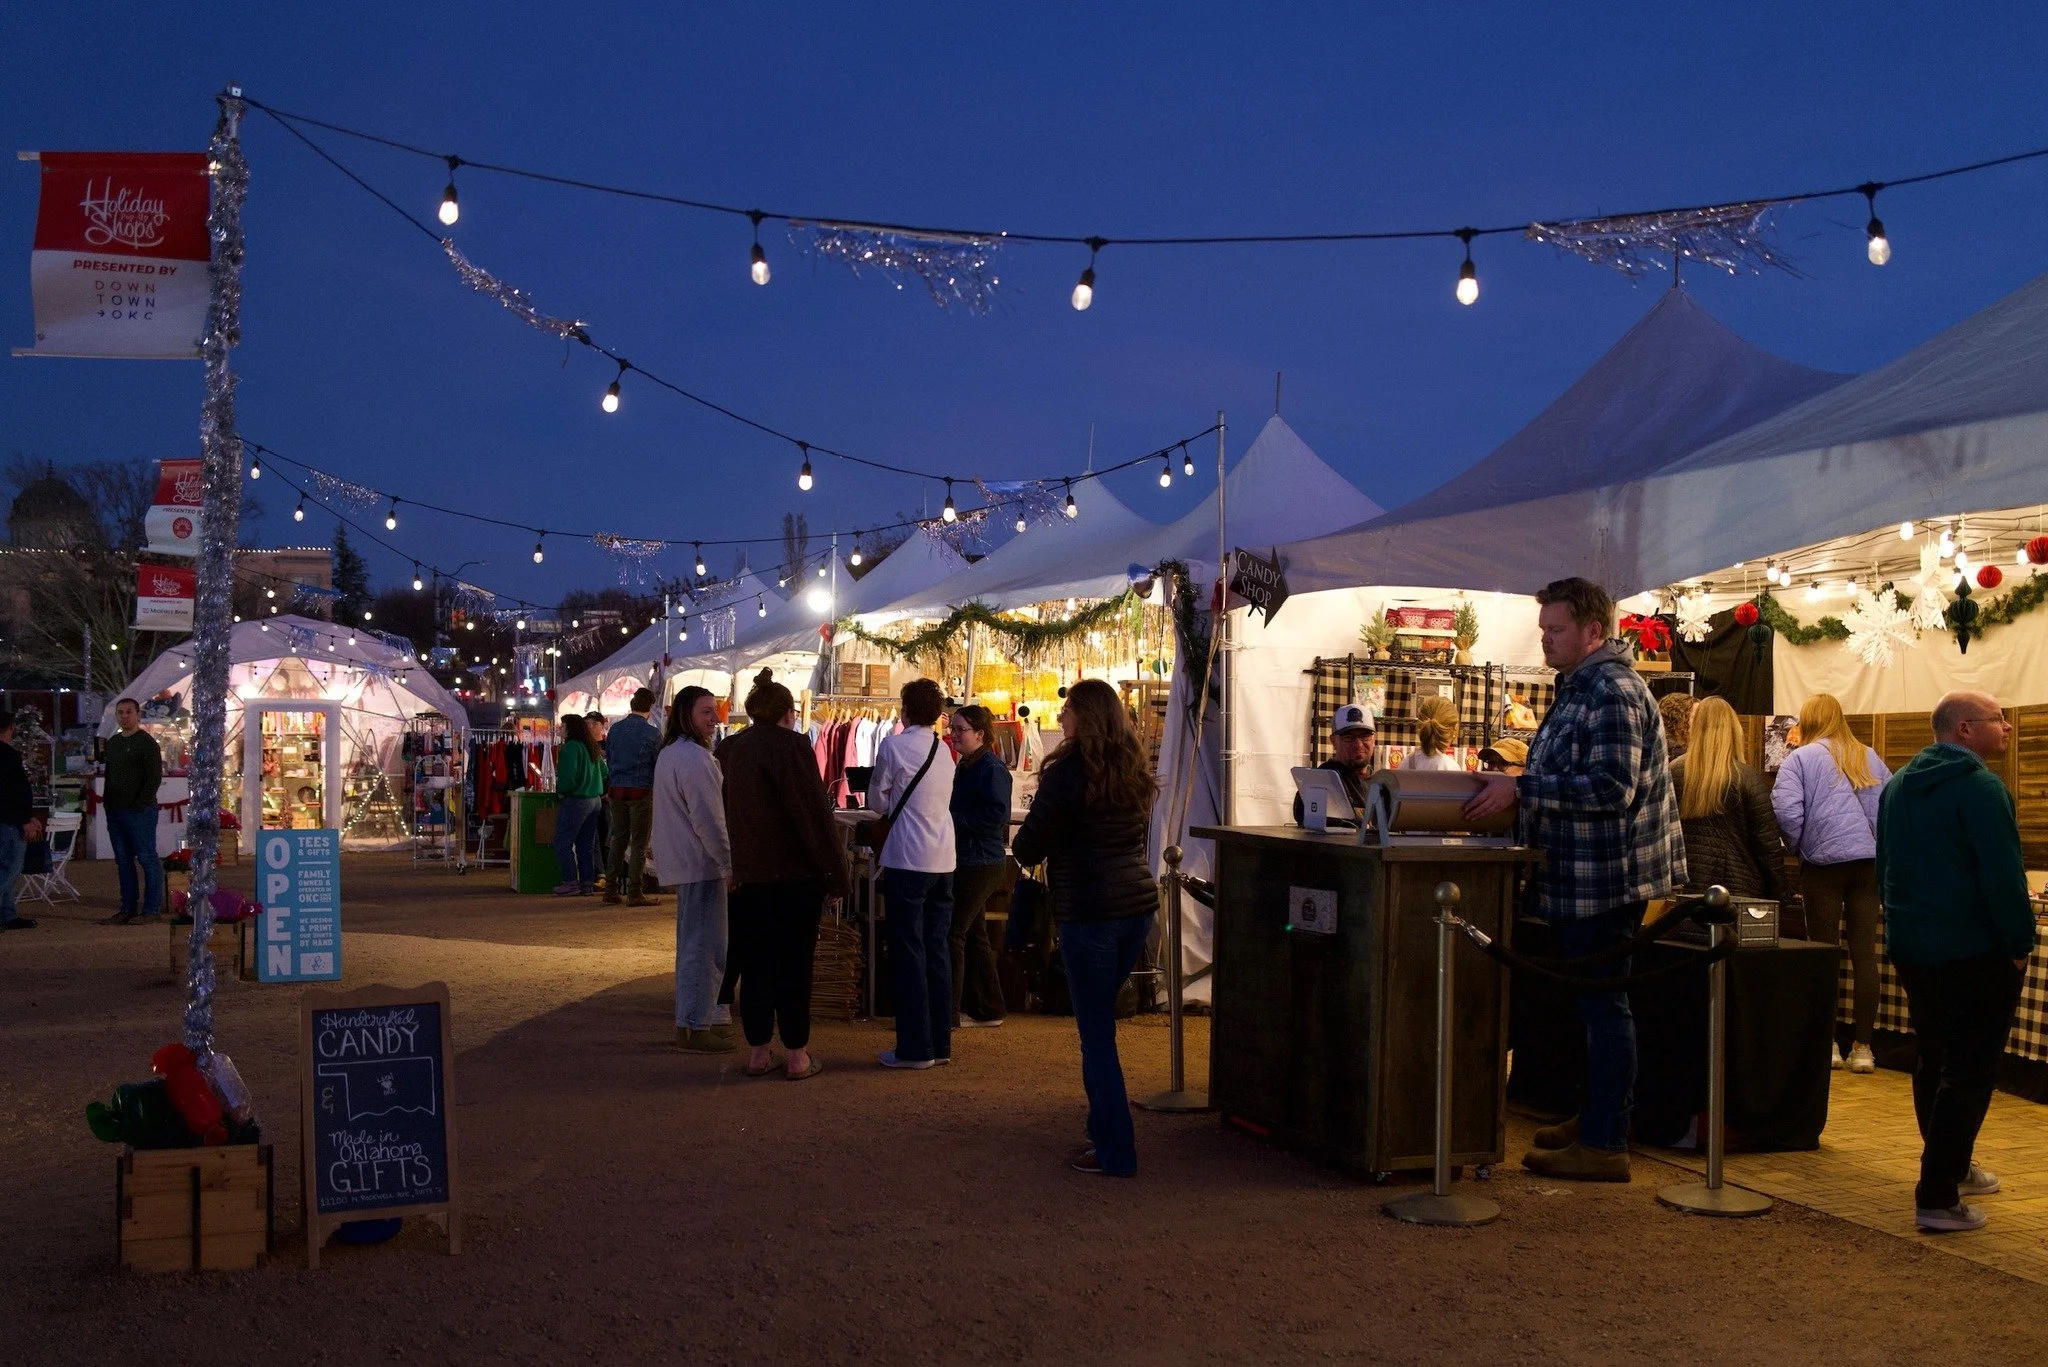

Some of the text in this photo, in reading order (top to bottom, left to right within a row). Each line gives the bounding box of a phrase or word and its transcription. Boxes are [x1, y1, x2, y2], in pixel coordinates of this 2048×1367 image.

[80, 176, 170, 225] Holiday
[85, 212, 164, 249] Shops
[73, 259, 177, 276] PRESENTED BY
[95, 280, 156, 293] DOWN
[96, 294, 155, 308] TOWN
[112, 309, 153, 320] OKC
[163, 507, 196, 515] PRESENTED
[1237, 551, 1281, 588] CANDY
[1240, 576, 1272, 607] SHOP
[298, 836, 330, 848] TEES
[298, 848, 331, 856] & GIFTS
[298, 869, 331, 879] FAMILY
[265, 836, 291, 976] OPEN
[298, 893, 319, 903] OKC
[308, 924, 333, 932] PRINT
[299, 938, 333, 947] BY HAND
[321, 1008, 420, 1029] Handcrafted
[318, 1024, 420, 1058] CANDY
[328, 1130, 400, 1147] Made in
[340, 1142, 423, 1163] Oklahoma
[329, 1155, 432, 1193] GIFTS
